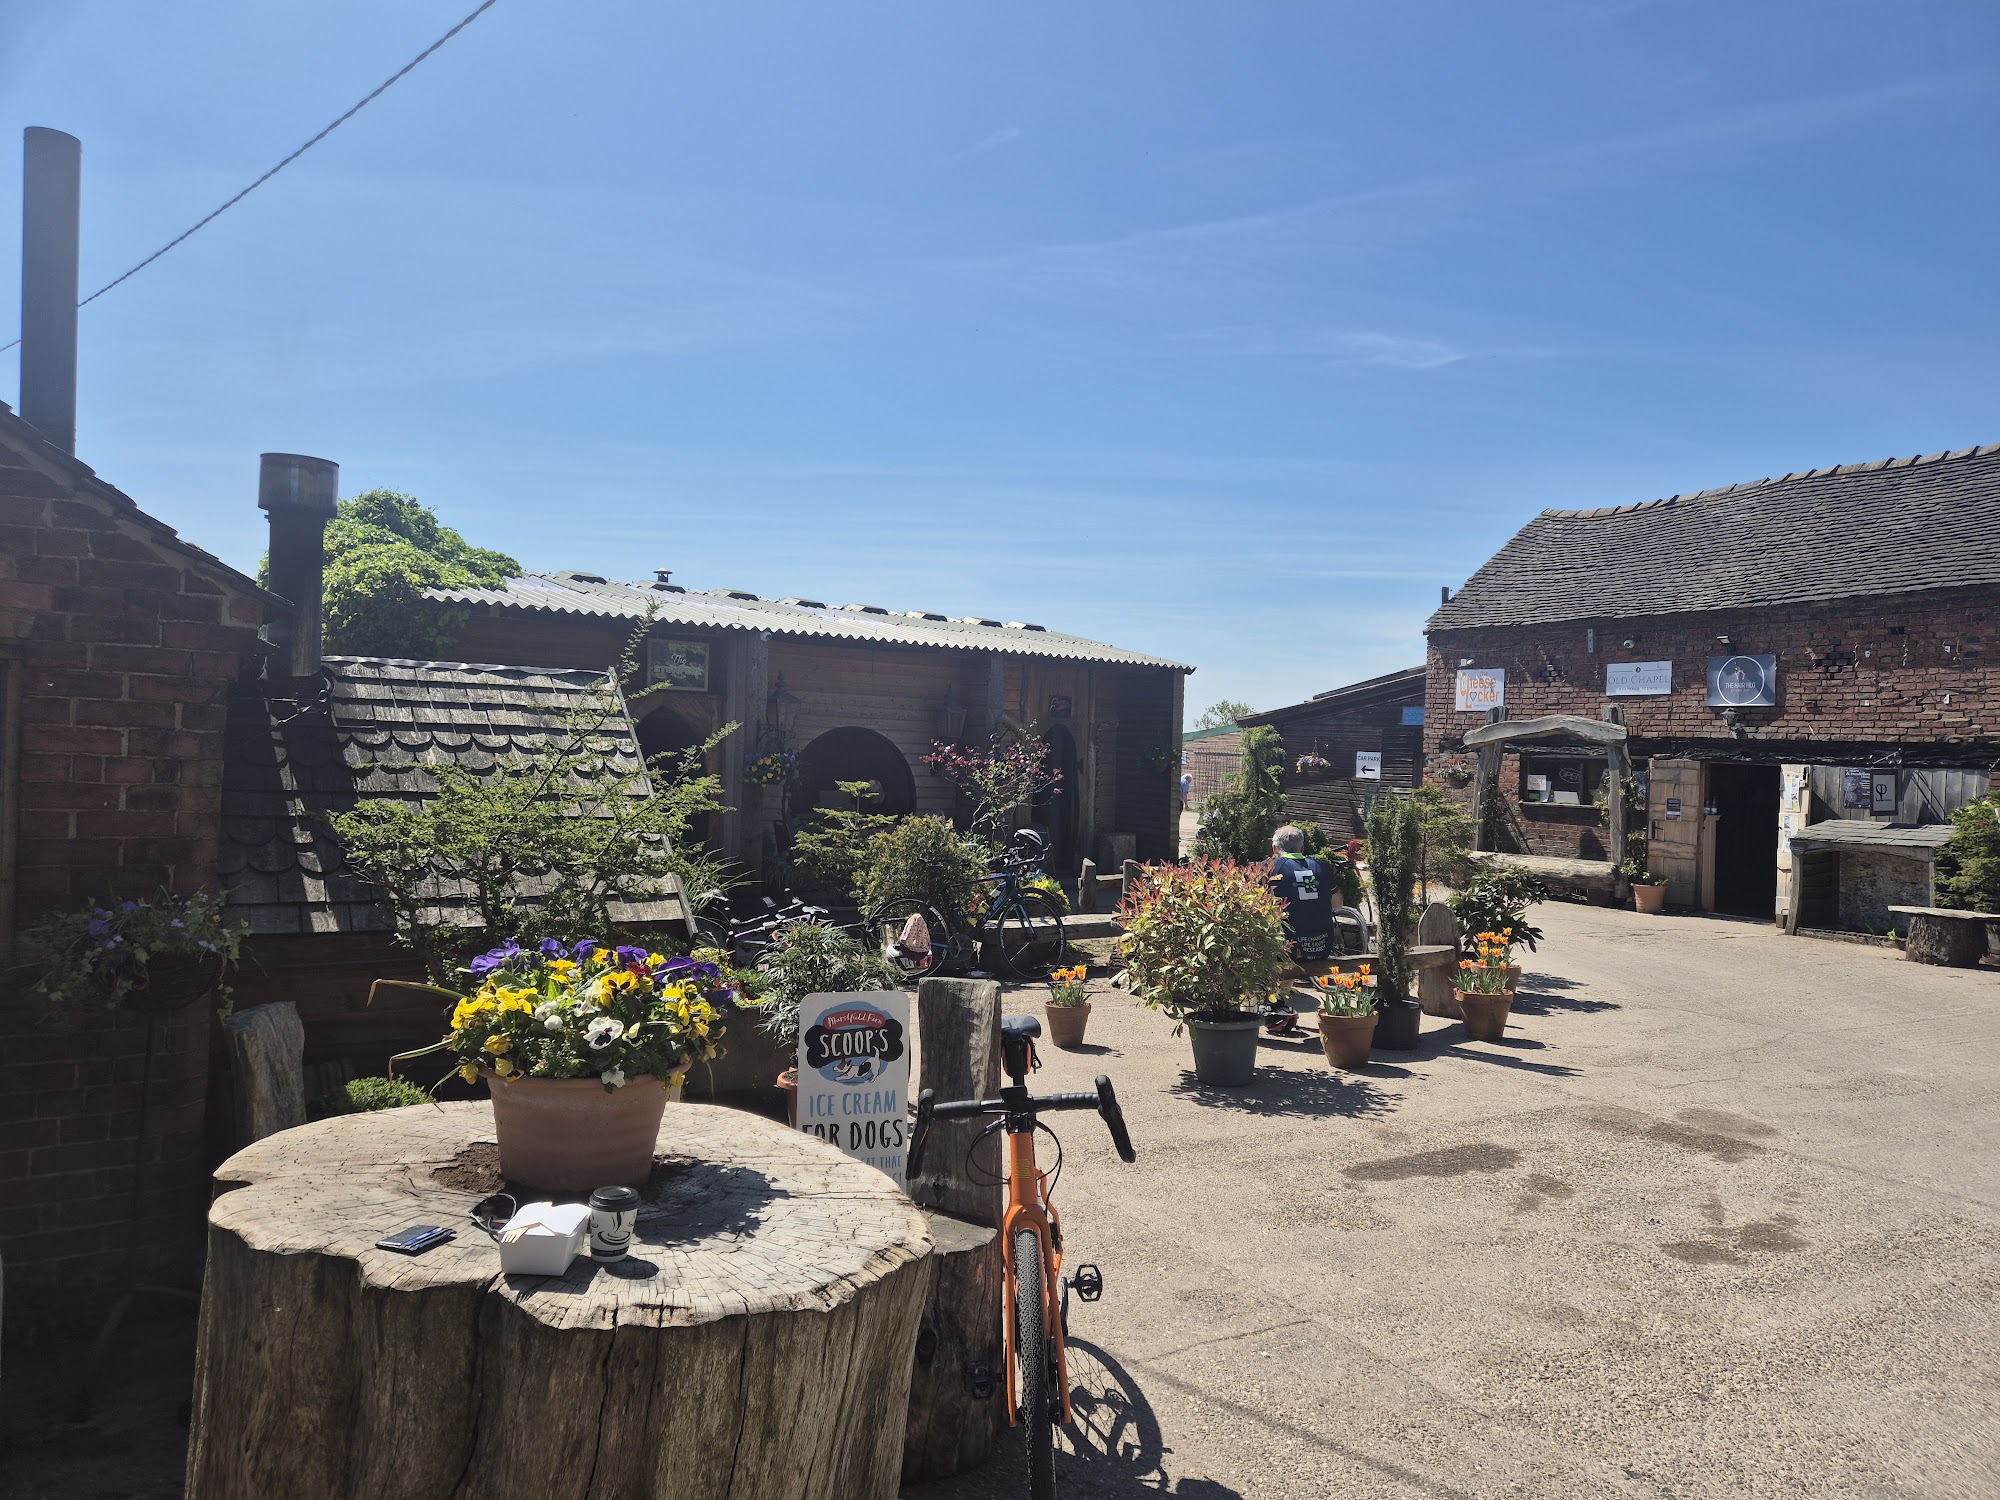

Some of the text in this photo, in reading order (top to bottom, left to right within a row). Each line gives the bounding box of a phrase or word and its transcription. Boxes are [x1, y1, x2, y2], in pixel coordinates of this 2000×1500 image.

[1460, 672, 1497, 696] Cheese
[1608, 675, 1671, 685] OLD CHAPEL
[819, 1028, 889, 1058] SCOOP'S
[809, 1089, 897, 1118] ICE CREAM
[850, 1119, 903, 1150] DOGS
[880, 1155, 902, 1169] THAT
